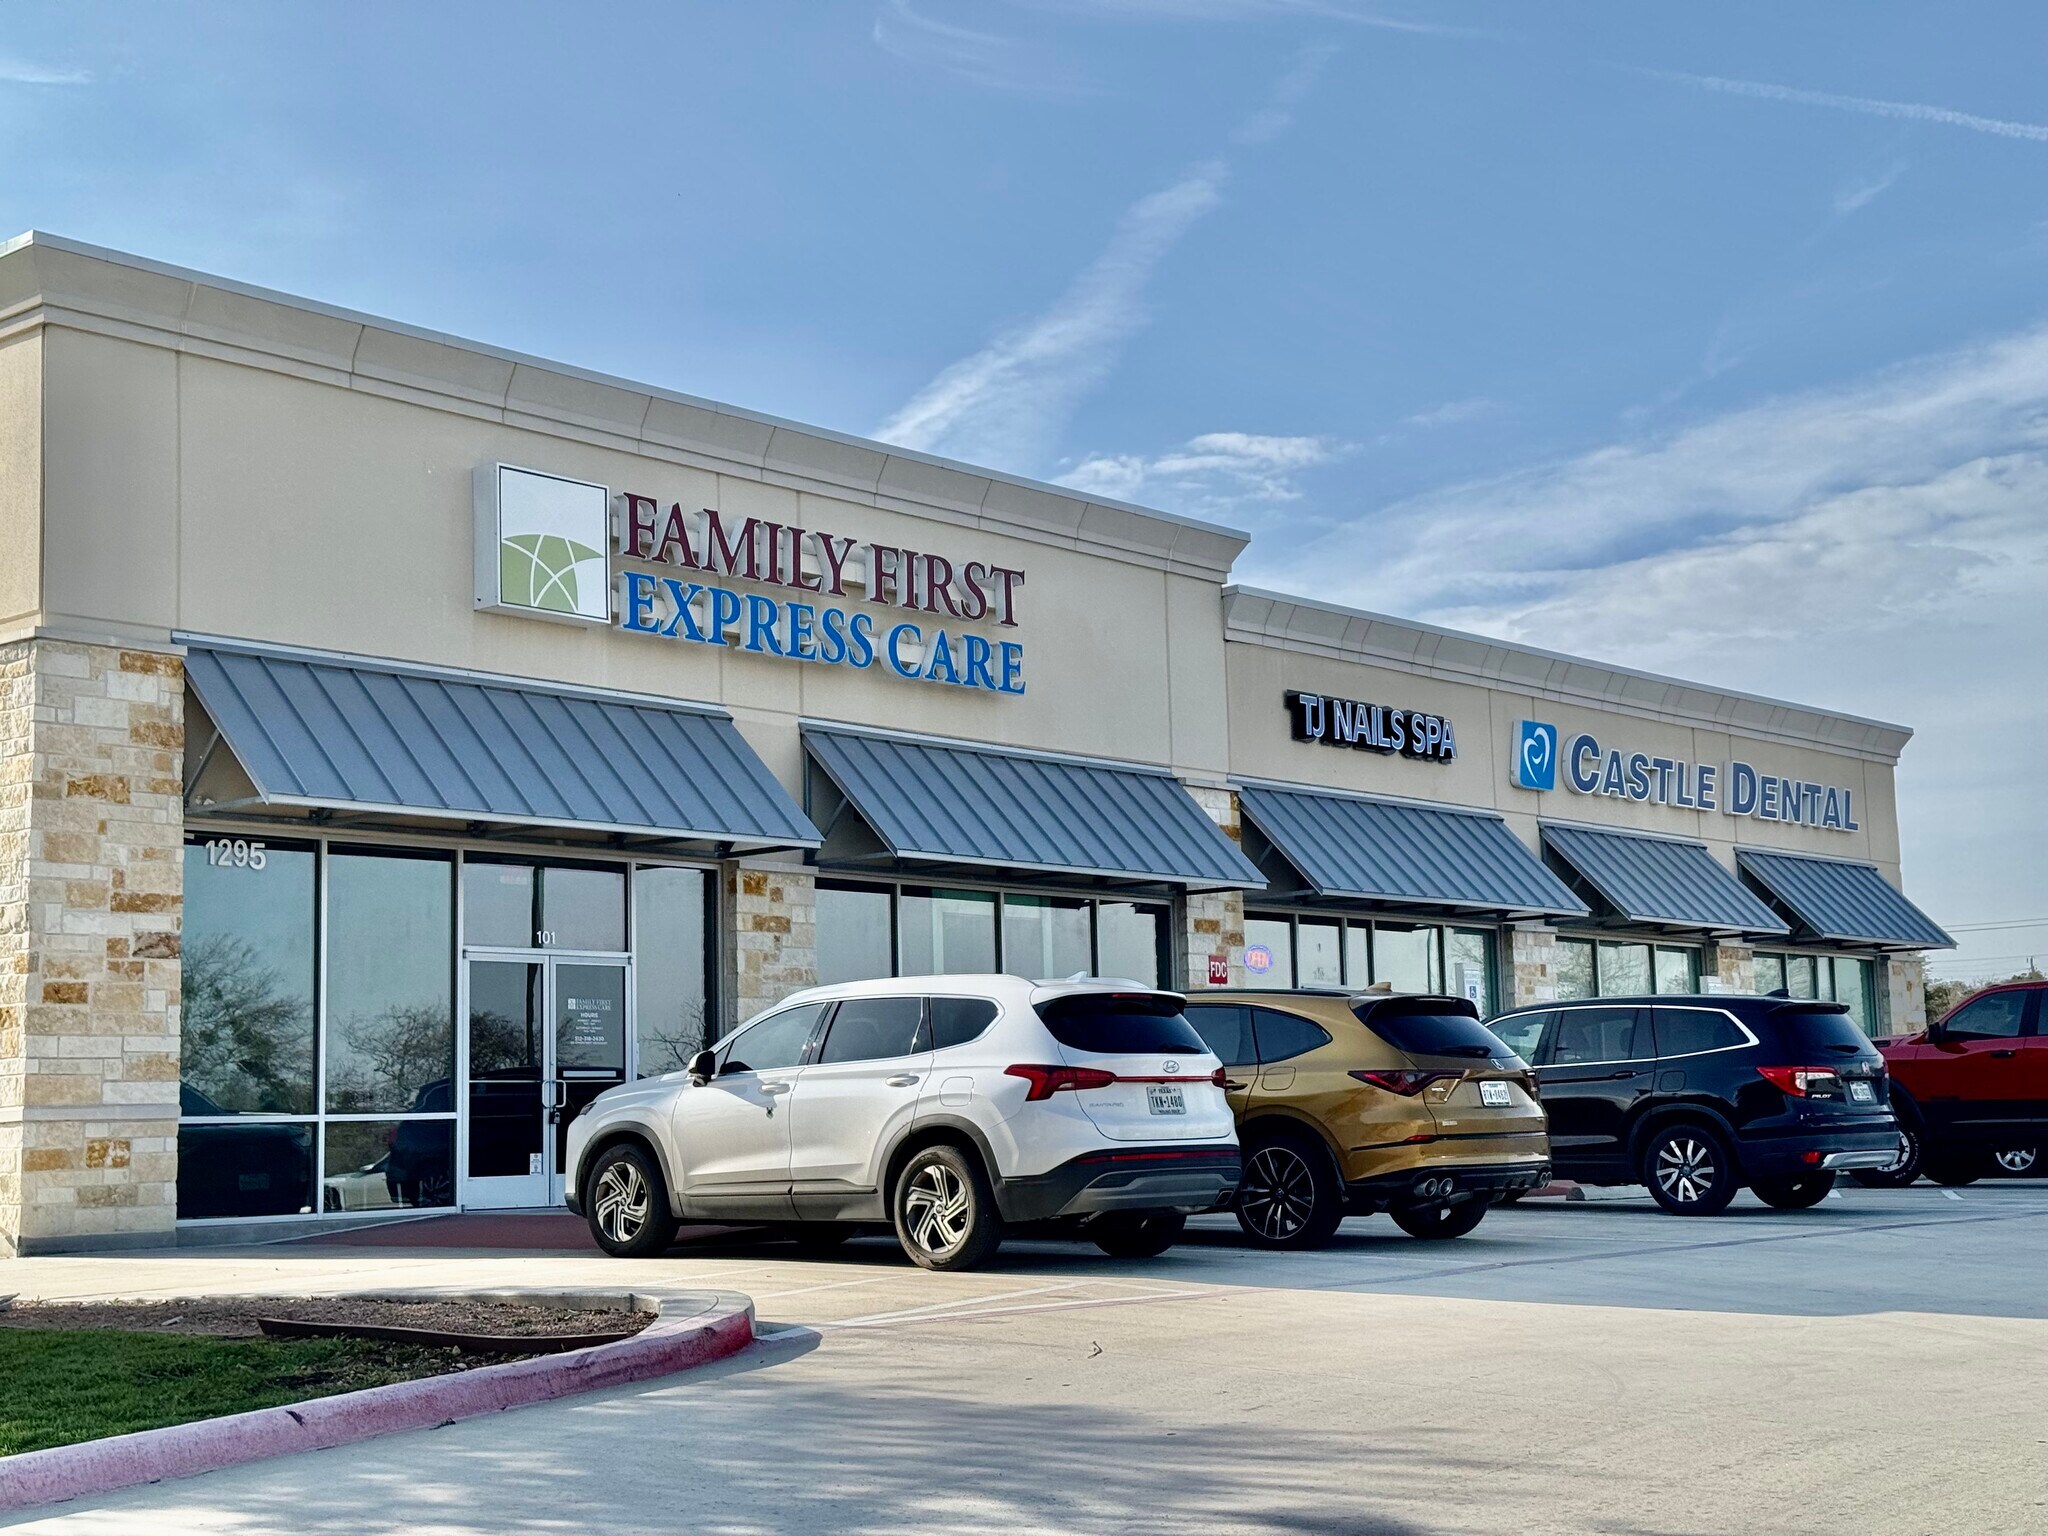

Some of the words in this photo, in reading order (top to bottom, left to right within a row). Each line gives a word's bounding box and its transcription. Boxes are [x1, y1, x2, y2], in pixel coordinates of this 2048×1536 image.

[622, 491, 858, 598] FAMILY
[869, 542, 1026, 627] FIRST
[622, 570, 875, 669] EXPRESS
[887, 623, 1027, 695] CARE
[1299, 693, 1326, 739] TJ
[1333, 699, 1406, 751] NAILS
[1411, 713, 1458, 759] SPA
[1571, 733, 1717, 812] CASTLE
[1731, 760, 1860, 833] DENTAL
[205, 838, 267, 871] 1295
[536, 930, 556, 945] 101
[1210, 961, 1227, 978] FDC
